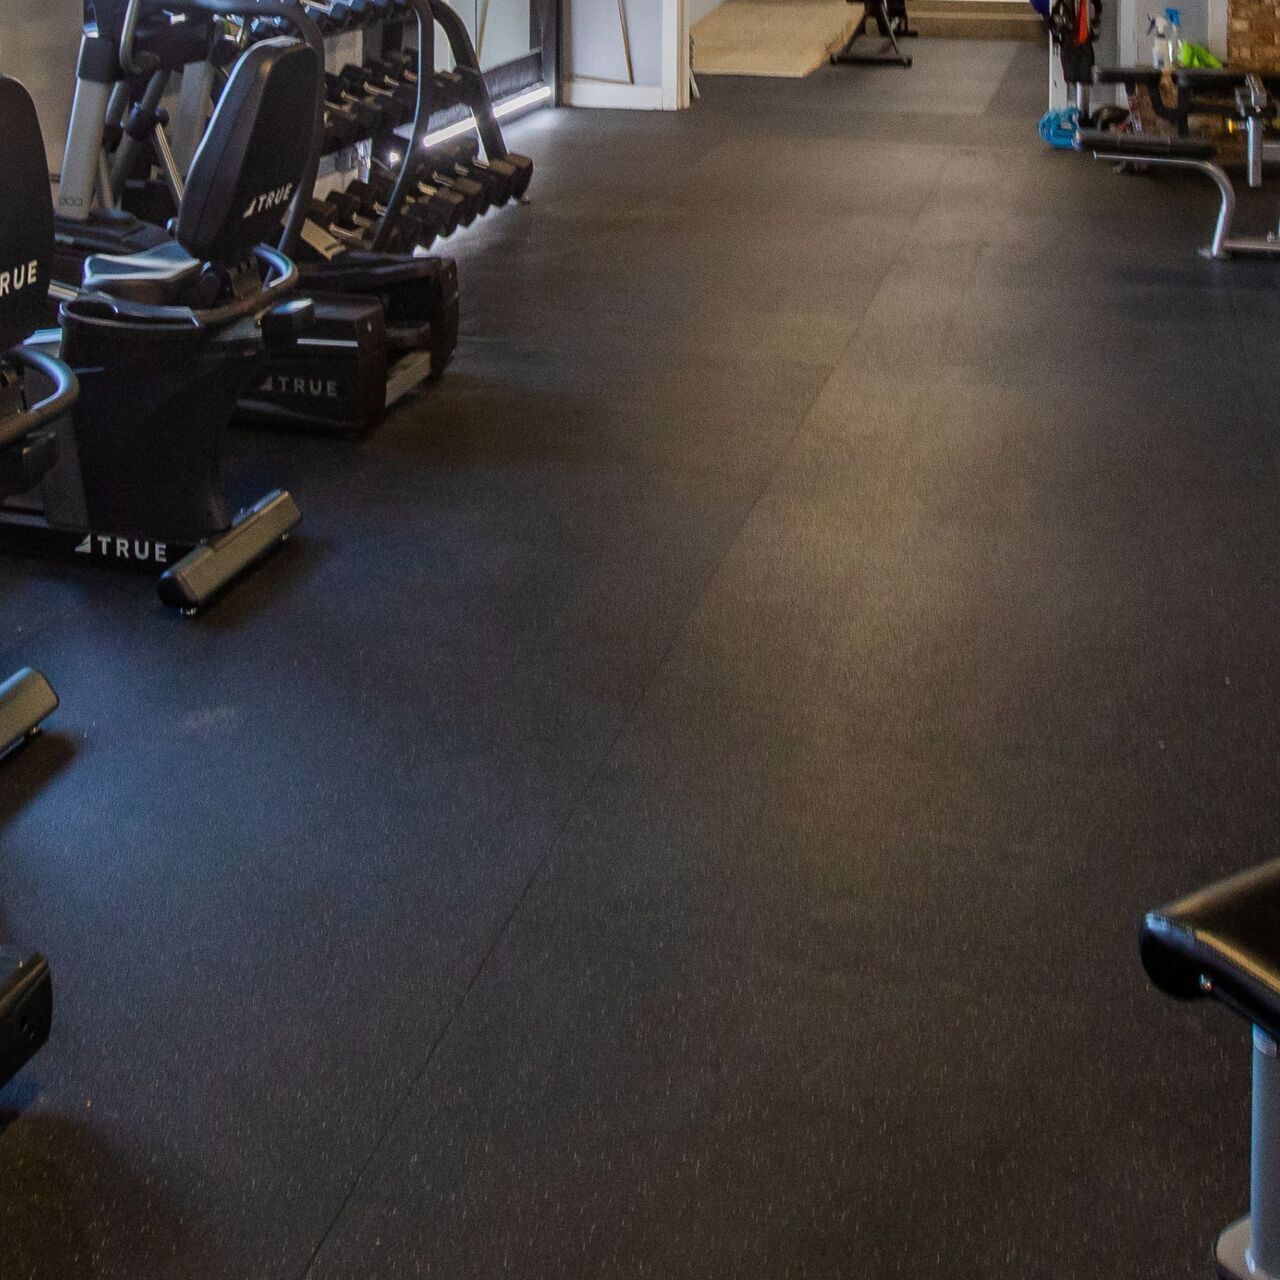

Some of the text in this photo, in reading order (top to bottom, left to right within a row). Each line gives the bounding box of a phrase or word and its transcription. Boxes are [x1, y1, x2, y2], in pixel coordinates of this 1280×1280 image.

[256, 182, 293, 213] TRUE
[278, 376, 338, 397] TRUE
[97, 535, 167, 563] TRUE
